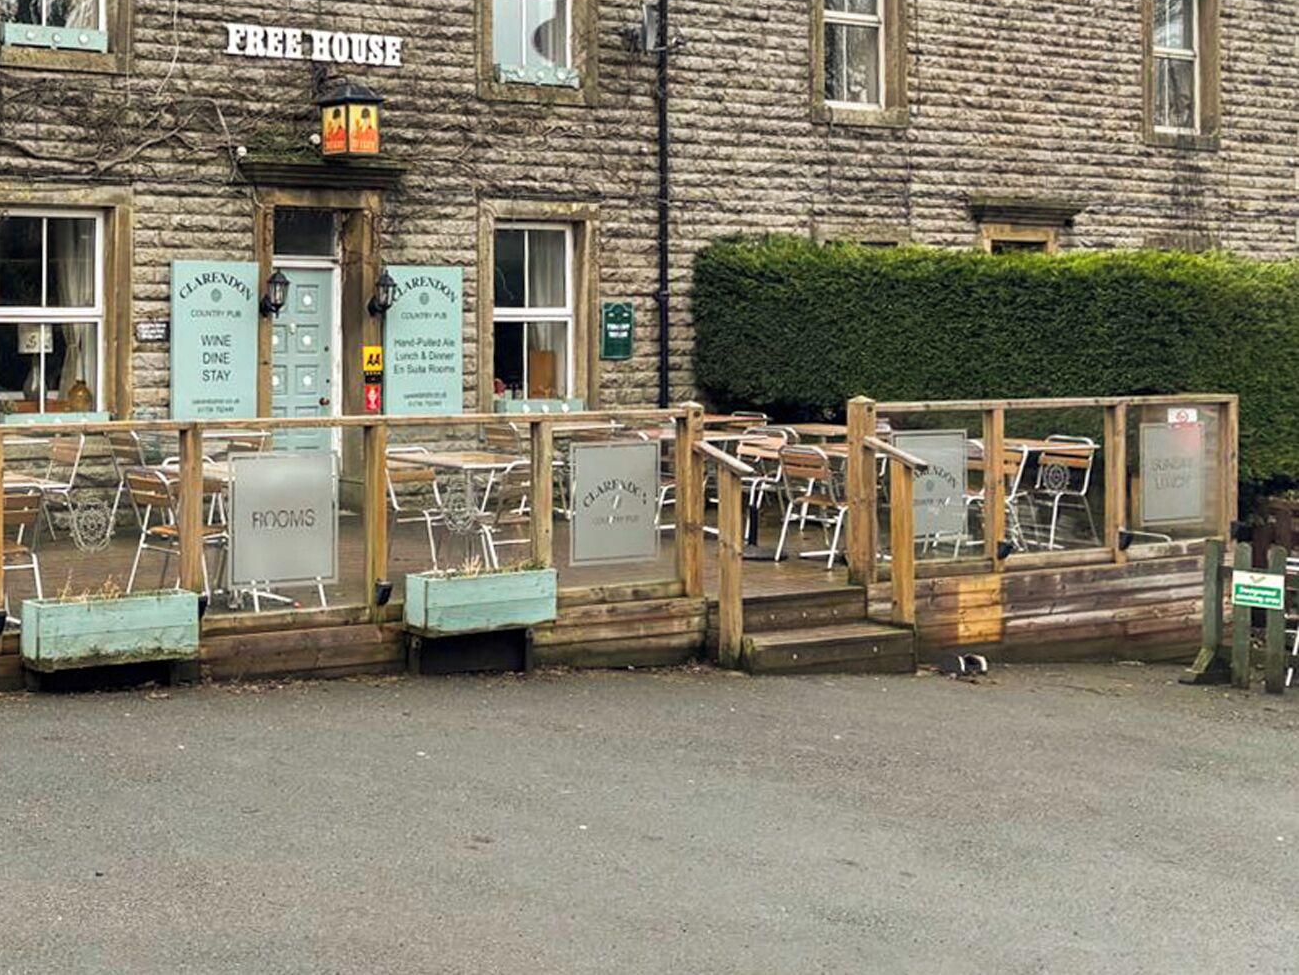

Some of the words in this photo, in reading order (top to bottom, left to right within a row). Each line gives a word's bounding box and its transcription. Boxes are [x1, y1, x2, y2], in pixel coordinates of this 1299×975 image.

[226, 24, 303, 60] FREE
[311, 29, 403, 67] HOUSE
[179, 272, 254, 302] CLARENDON
[191, 309, 225, 318] COUNTRY
[227, 309, 242, 318] PUB
[201, 334, 232, 347] WINE
[202, 352, 231, 365] DINE
[367, 353, 382, 365] AA
[395, 351, 419, 361] Lunch
[429, 351, 455, 361] Dinner
[202, 369, 231, 382] STAY
[429, 364, 455, 374] Rooms
[252, 508, 316, 528] ROOMS
